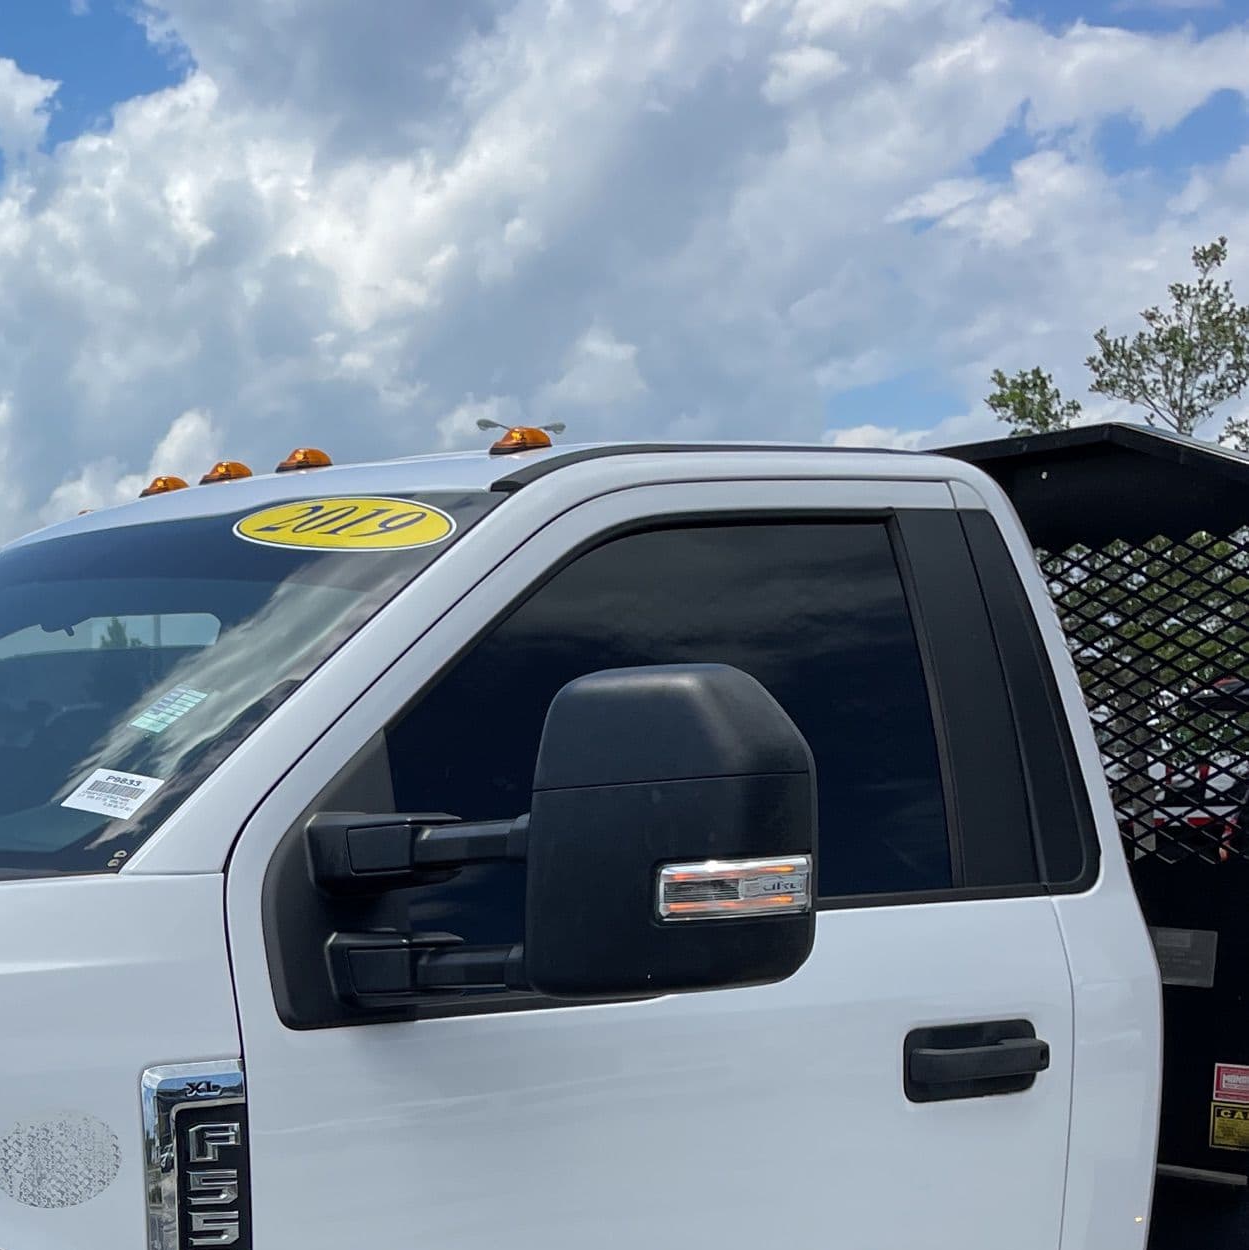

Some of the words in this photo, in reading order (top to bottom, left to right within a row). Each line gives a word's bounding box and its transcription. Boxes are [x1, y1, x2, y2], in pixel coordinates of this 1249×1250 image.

[253, 505, 427, 538] 2019
[185, 1081, 222, 1096] XL
[1220, 1109, 1249, 1120] CA
